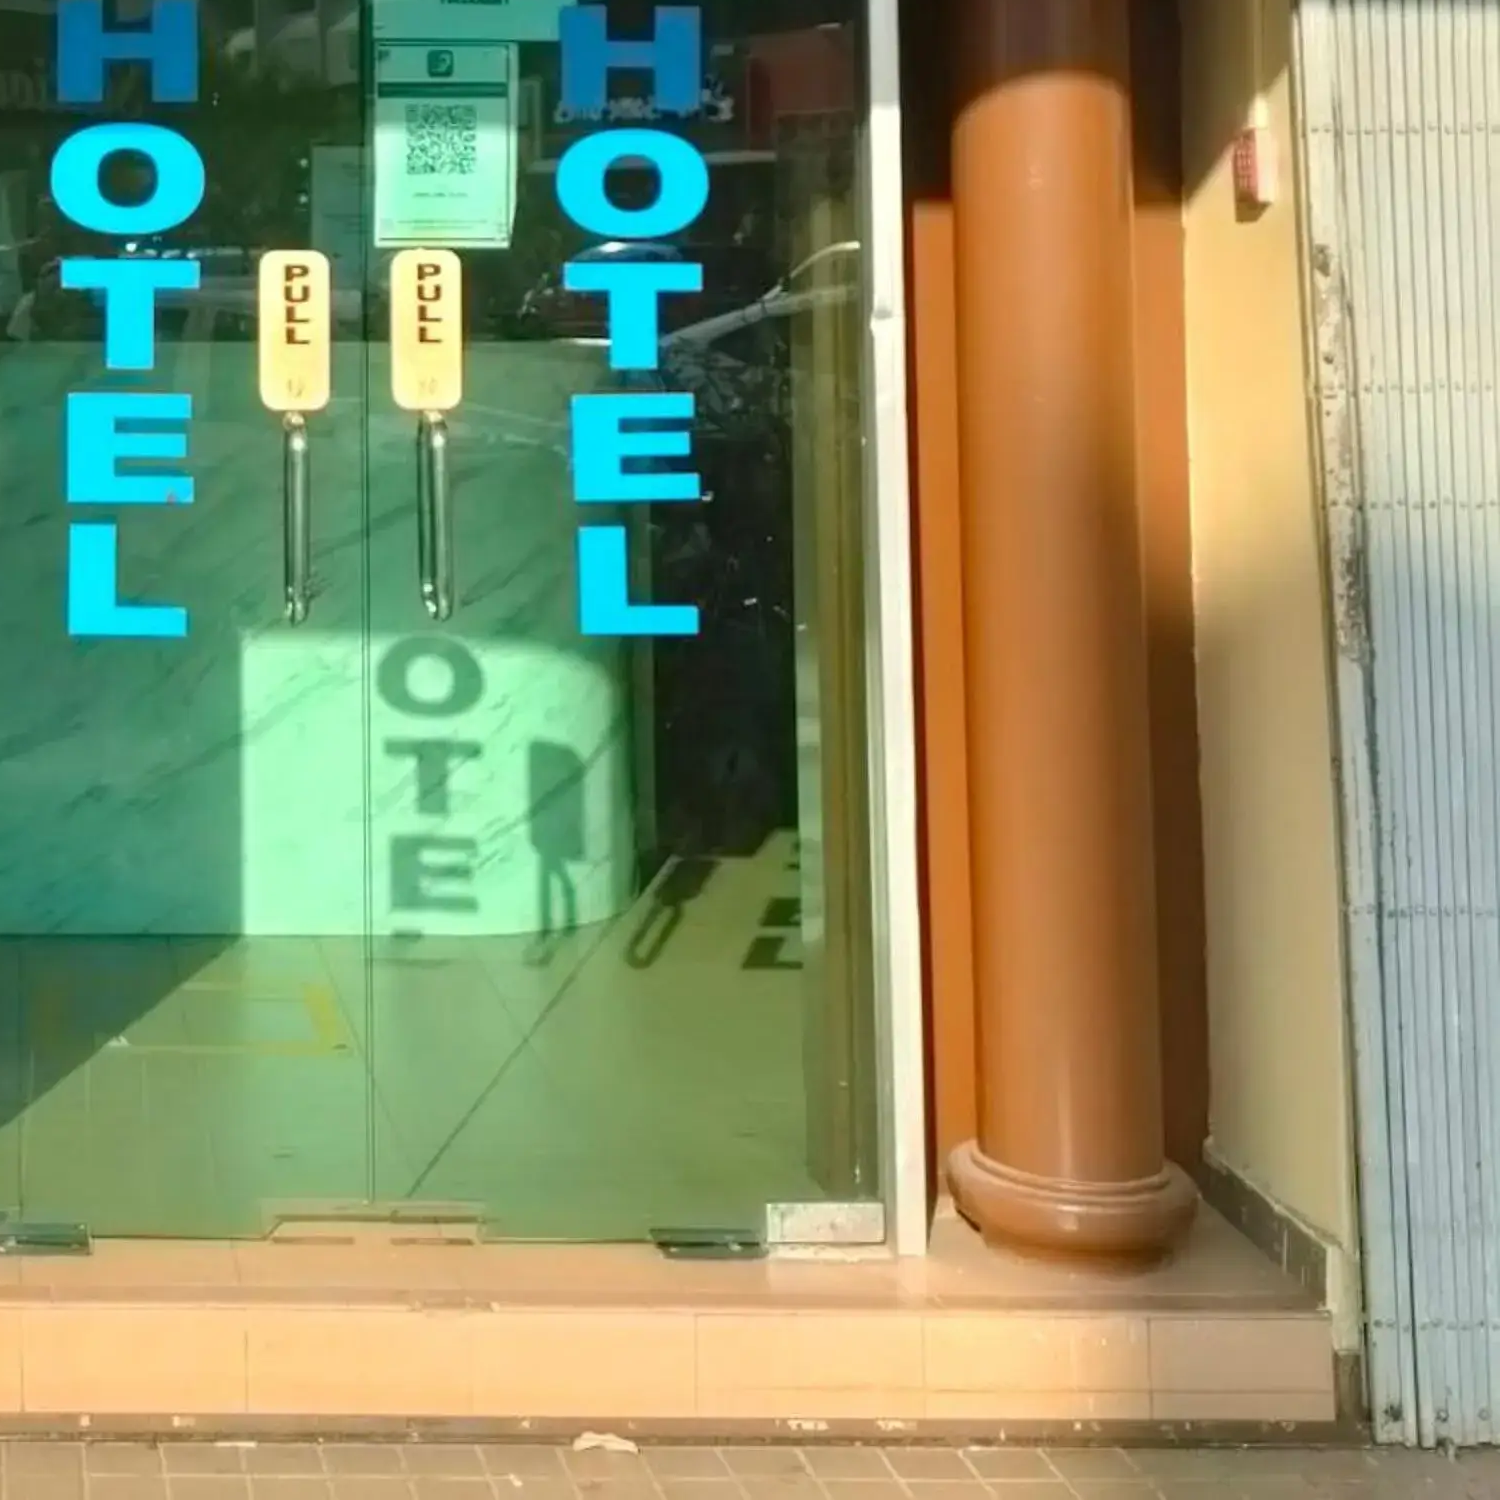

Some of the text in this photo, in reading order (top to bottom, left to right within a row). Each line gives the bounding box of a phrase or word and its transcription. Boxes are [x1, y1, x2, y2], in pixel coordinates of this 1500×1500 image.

[284, 264, 311, 345] PULL
[417, 263, 443, 344] PULL
[556, 5, 709, 636] HOTEL
